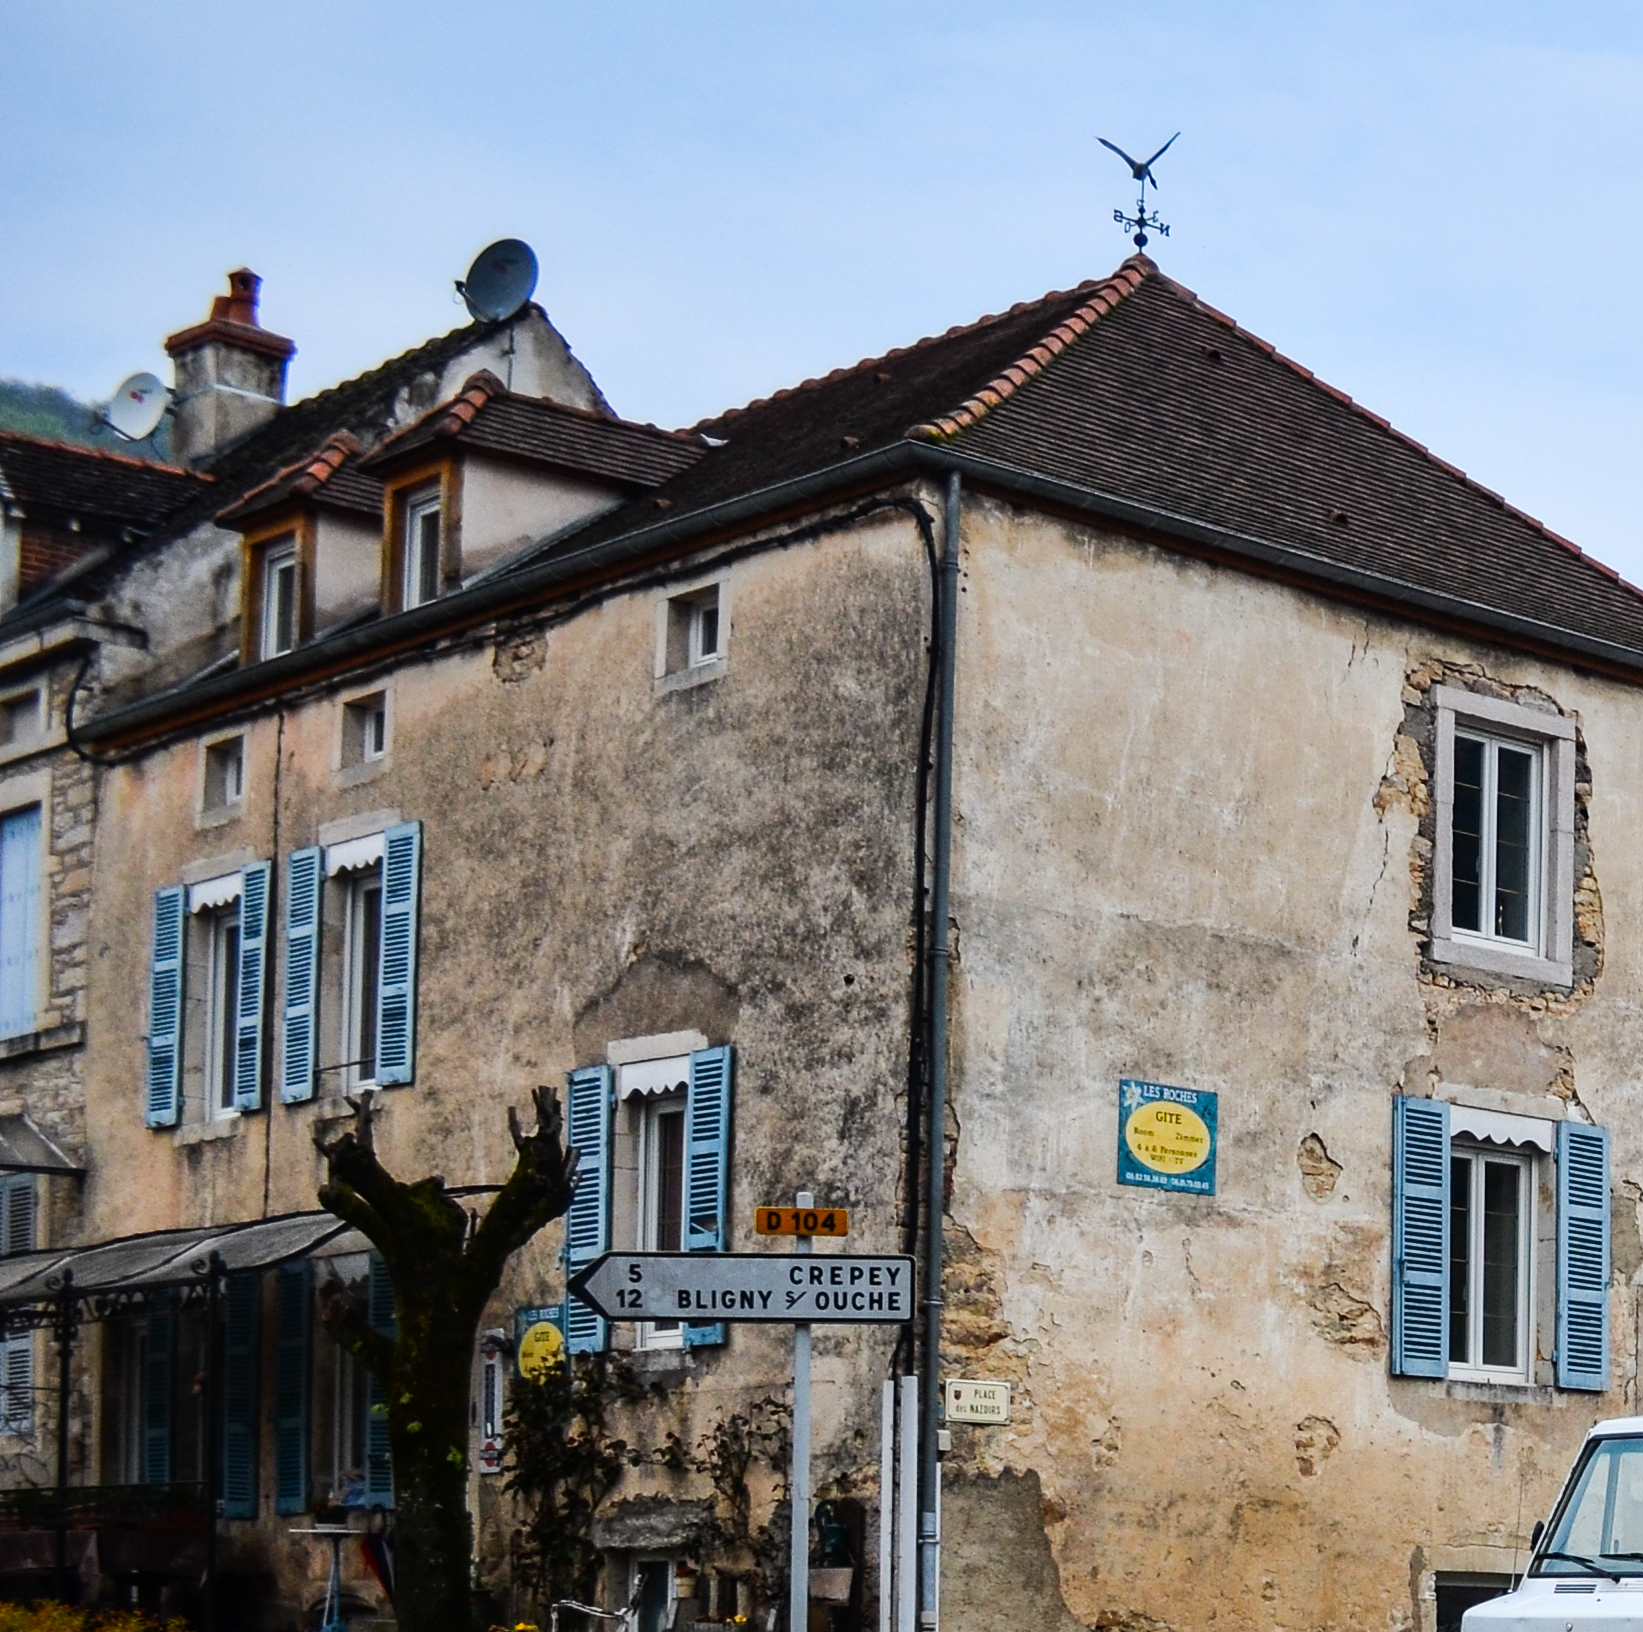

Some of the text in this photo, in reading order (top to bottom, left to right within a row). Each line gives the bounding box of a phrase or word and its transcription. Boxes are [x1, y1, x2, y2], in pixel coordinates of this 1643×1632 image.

[1143, 1085, 1197, 1104] LES ROCHES
[1155, 1111, 1182, 1125] GITE
[767, 1212, 836, 1232] D 104
[628, 1264, 901, 1286] 5 CREPEY
[616, 1289, 643, 1309] 12
[678, 1289, 773, 1310] BLIGNY
[815, 1292, 901, 1311] OUCHE
[974, 1389, 996, 1400] PLACE
